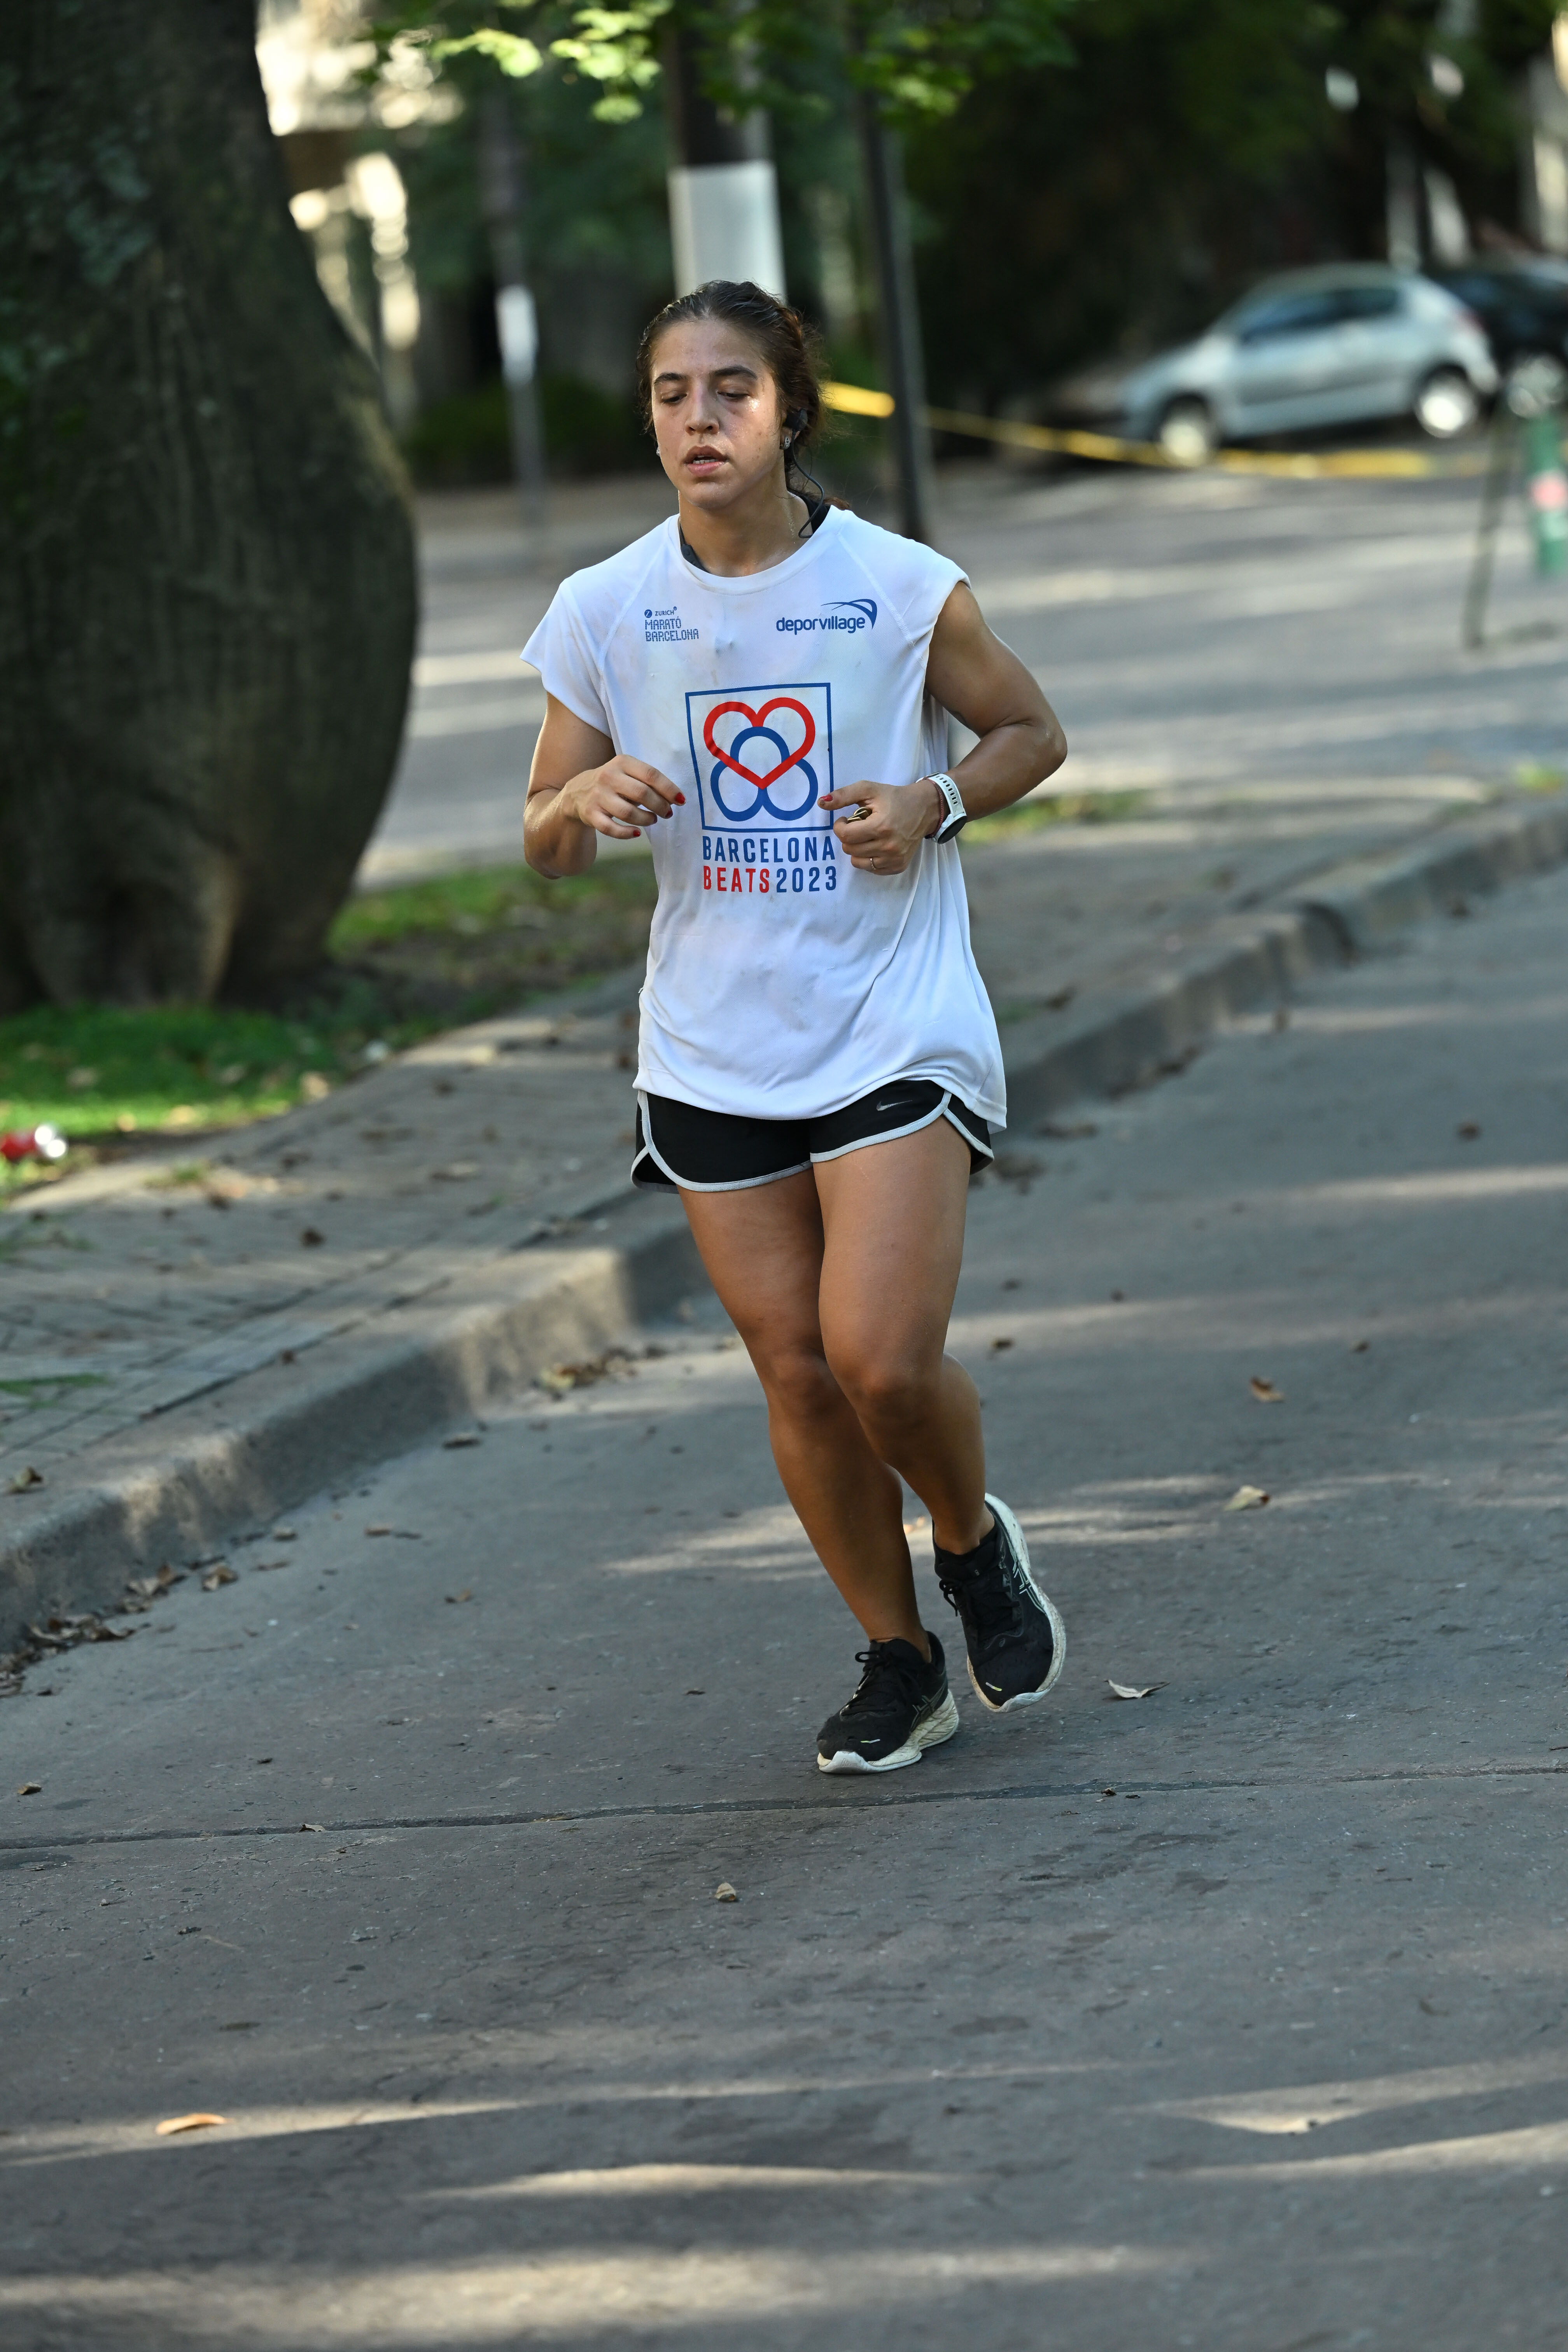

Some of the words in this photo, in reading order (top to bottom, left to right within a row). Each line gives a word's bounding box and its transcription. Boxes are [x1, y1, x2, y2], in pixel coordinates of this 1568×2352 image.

[645, 616, 681, 630] MARATÓ
[776, 616, 866, 635] deporvillage
[645, 628, 699, 642] BARCELONA
[702, 836, 835, 863] BARCELONA
[703, 865, 770, 893] BEATS
[776, 866, 837, 893] 2023
